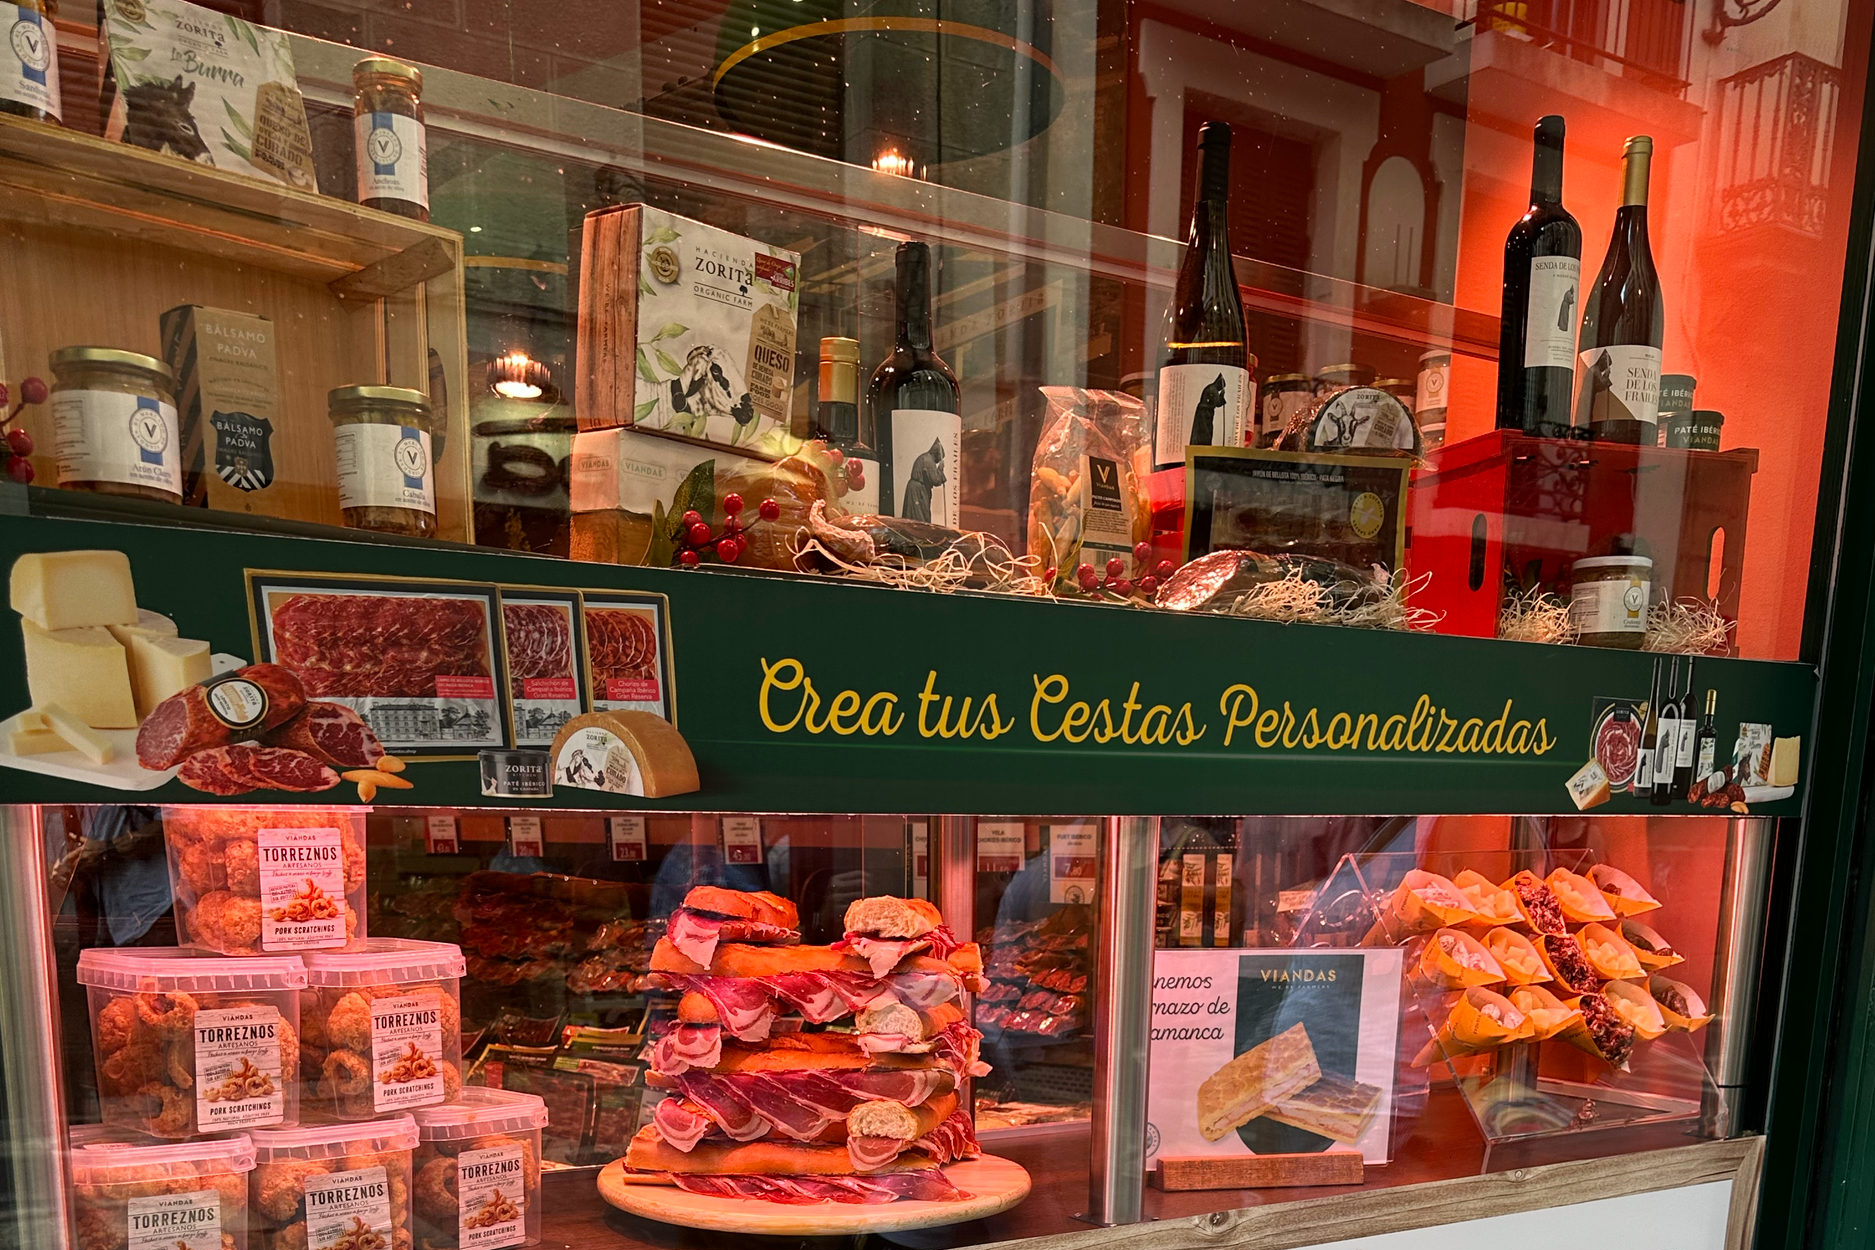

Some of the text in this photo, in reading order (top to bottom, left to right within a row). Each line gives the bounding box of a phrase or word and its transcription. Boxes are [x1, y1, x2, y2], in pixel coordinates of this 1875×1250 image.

[183, 50, 244, 88] Burra
[695, 246, 754, 269] HACIENDA
[1535, 261, 1558, 271] SENDA
[1559, 262, 1567, 270] DE
[694, 285, 753, 308] ORGANIC FARM
[754, 344, 790, 373] QUESO
[1627, 367, 1657, 381] SENDA
[1626, 379, 1657, 392] DE LOS
[144, 421, 157, 438] V
[1674, 424, 1698, 435] PATÉ
[225, 437, 256, 448] PADVA
[407, 450, 418, 465] V
[581, 460, 610, 469] VIANDAS
[625, 462, 663, 477] VIANDAS
[1097, 464, 1110, 483] V
[760, 657, 1557, 755] Crea tus Cestas Personalizadas
[263, 847, 337, 861] TORREZNOS
[275, 925, 335, 935] PORK SCRATCHINGS
[1153, 976, 1213, 989] nemos
[1260, 968, 1337, 983] VIANDAS
[1207, 996, 1231, 1015] de
[375, 1011, 436, 1029] TORREZNOS
[200, 1025, 274, 1043] TORREZNOS
[1150, 1027, 1224, 1041] amanca
[218, 1041, 258, 1049] ARTESANOS
[383, 1083, 434, 1097] PORK SCRATCHINGS
[210, 1102, 271, 1115] PORK SCRATCHINGS
[462, 1160, 520, 1179] TORREZNOS
[332, 1176, 362, 1184] VIANDAS
[310, 1184, 384, 1206] TORREZNOS
[159, 1199, 193, 1207] VIANDAS
[329, 1200, 369, 1211] ARTESANOS
[133, 1208, 215, 1229] TORREZNOS
[153, 1224, 197, 1235] ARTESANOS
[468, 1225, 516, 1240] PORK SCRATCHINGS
